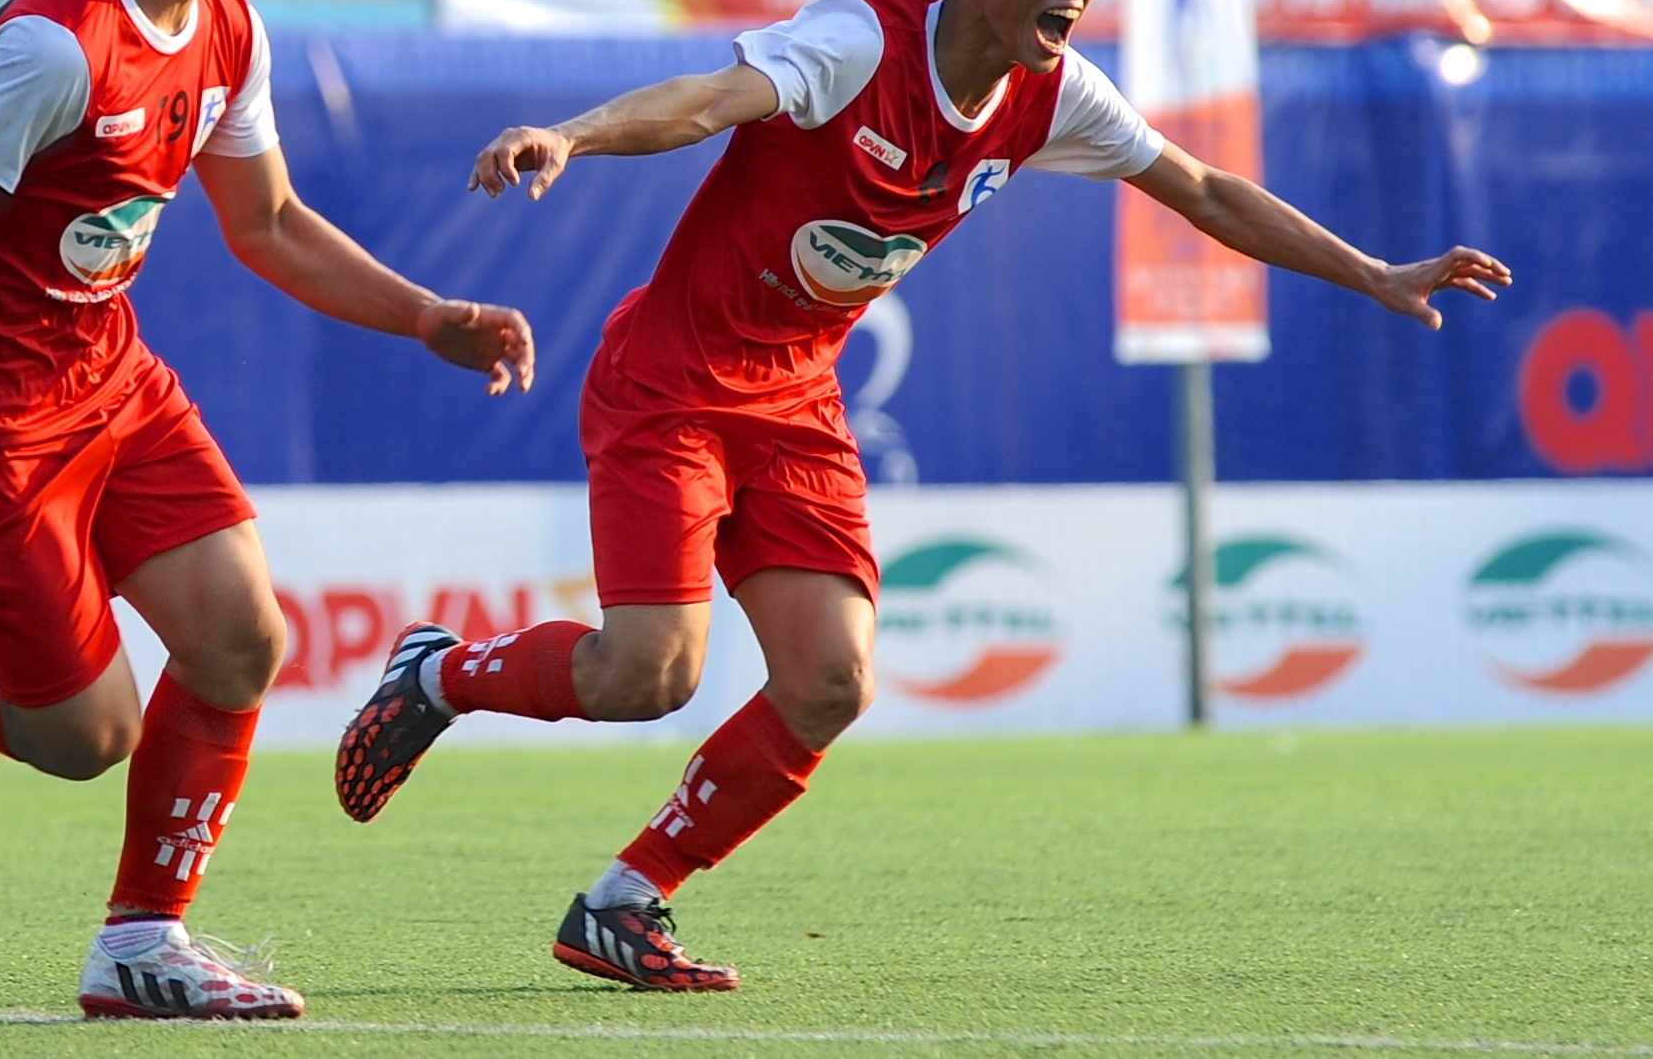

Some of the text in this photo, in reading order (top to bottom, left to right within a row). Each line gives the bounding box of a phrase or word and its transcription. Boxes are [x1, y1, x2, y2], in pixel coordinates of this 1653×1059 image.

[157, 90, 189, 145] 19
[858, 134, 887, 159] QPVN
[74, 230, 152, 250] VIETT
[809, 230, 907, 283] VIETT
